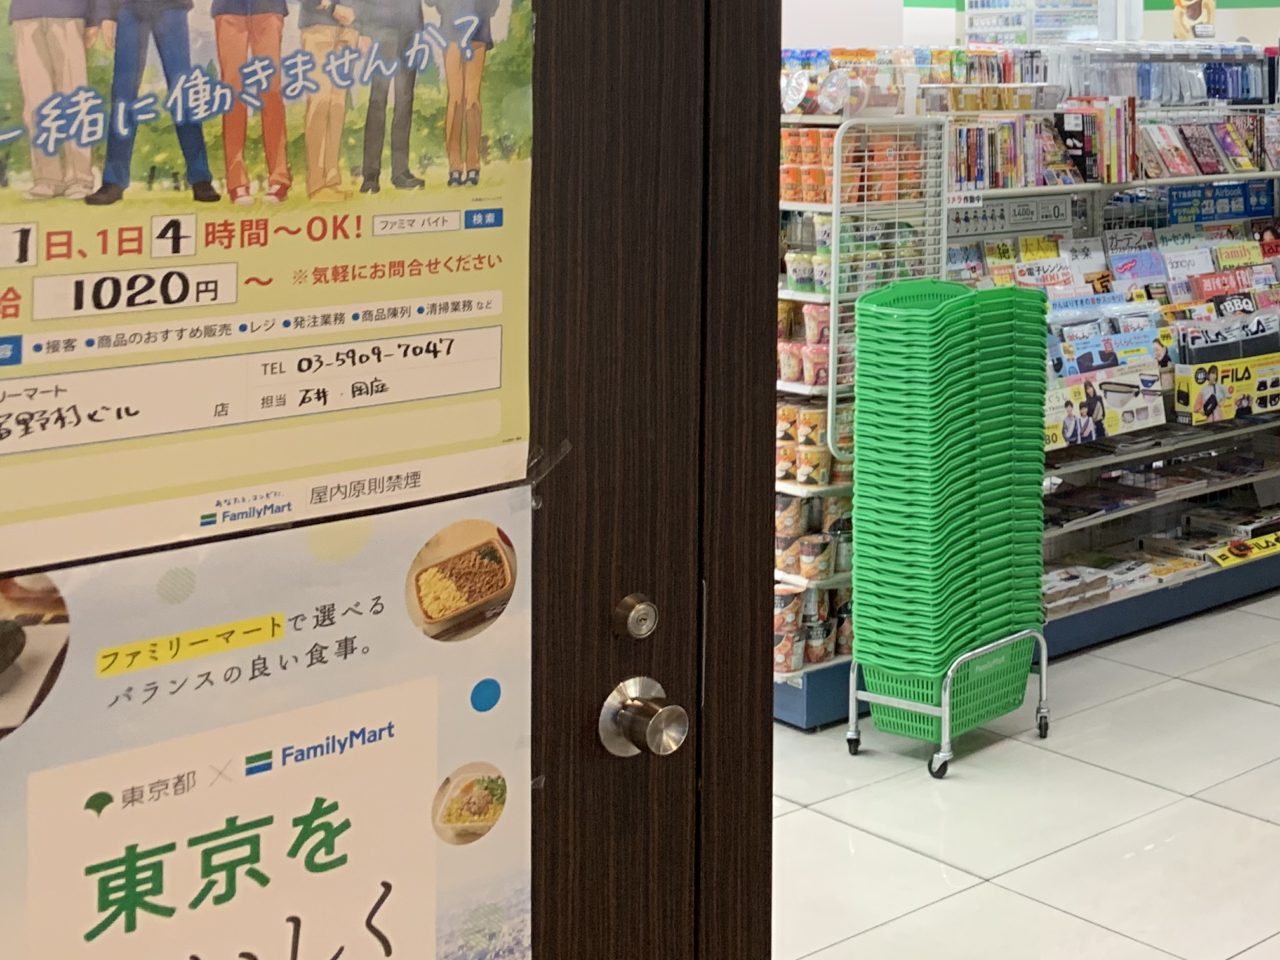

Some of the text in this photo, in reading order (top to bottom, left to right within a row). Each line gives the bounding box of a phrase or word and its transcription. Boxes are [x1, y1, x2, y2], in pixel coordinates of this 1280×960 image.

[472, 212, 496, 227] 検索
[1224, 297, 1255, 314] BBQ
[97, 323, 233, 349] 商品のおすすめ販売
[250, 317, 276, 333] レジ
[292, 311, 346, 329] 発注業務
[361, 305, 412, 322] 商品陳列
[426, 299, 473, 316] 清掃業務
[1190, 327, 1228, 345] FILA
[262, 362, 286, 375] TEL
[1221, 366, 1251, 384] FILA
[214, 402, 230, 417] 店
[261, 394, 287, 409] 担当
[309, 471, 422, 505] 屋内原則禁煙
[222, 502, 294, 522] FamilyMart
[100, 595, 386, 673] ファミリーマートで選べる
[107, 634, 371, 708] バランスの良い食事。
[121, 770, 196, 809] 東京都
[281, 721, 395, 766] FamilyMart
[83, 796, 352, 942] 東京を
